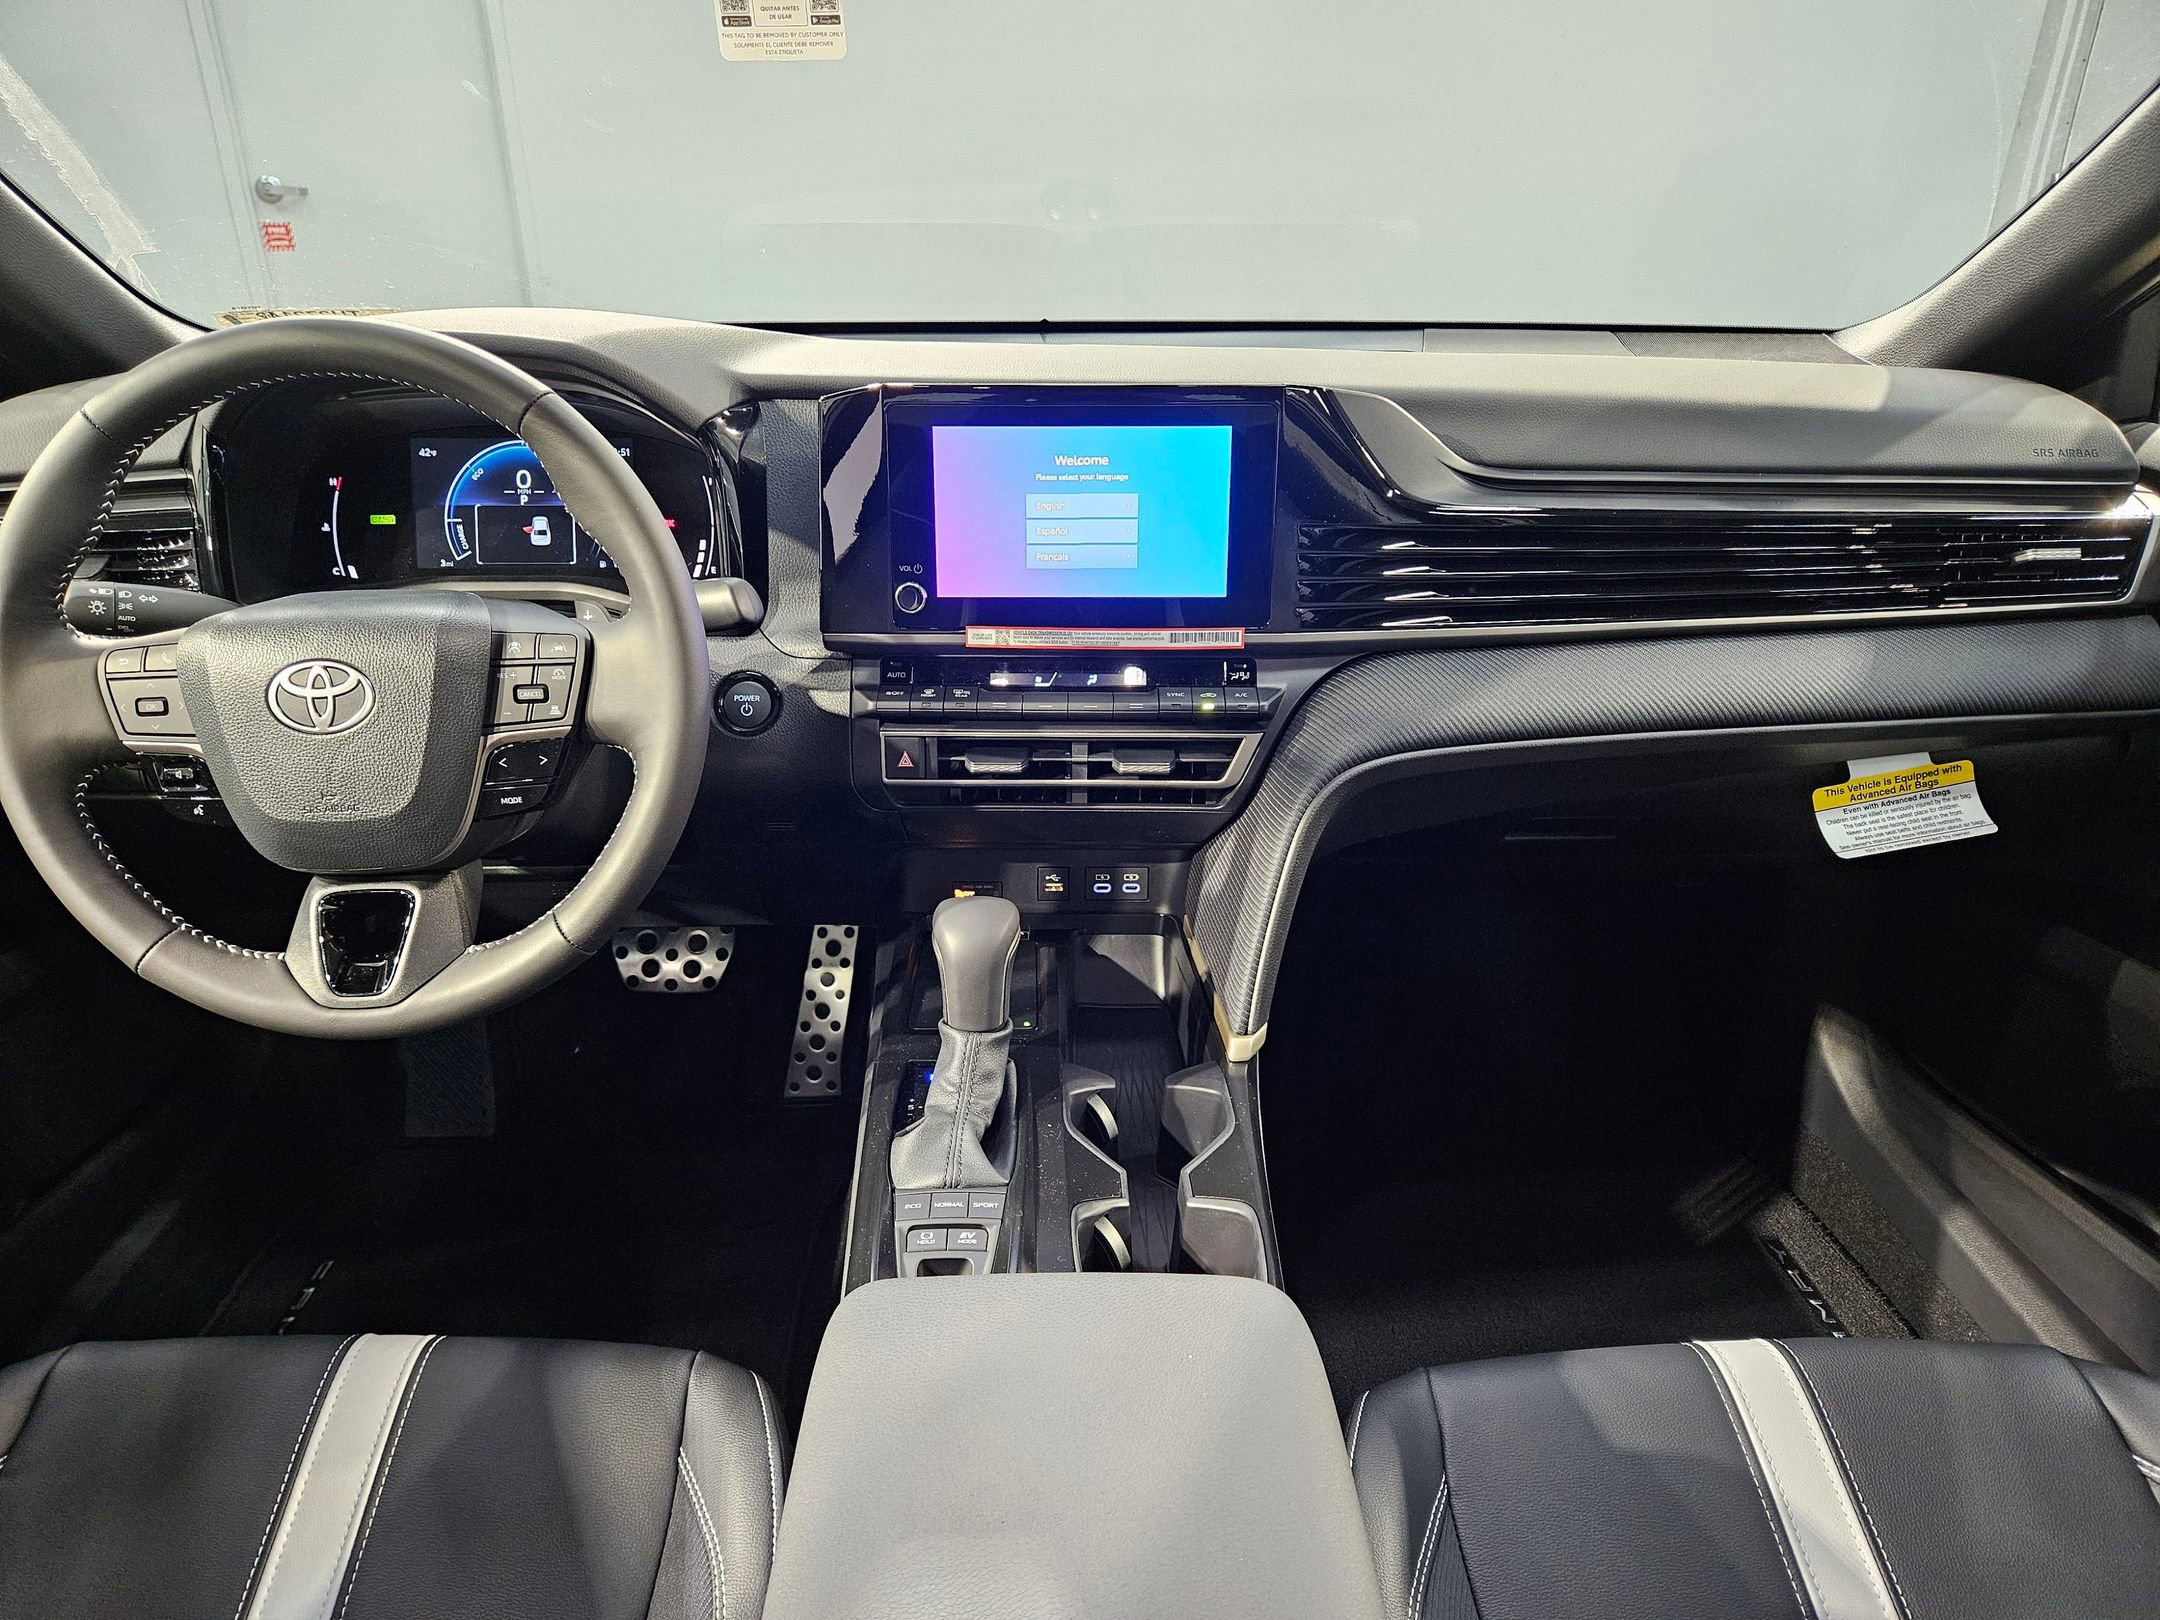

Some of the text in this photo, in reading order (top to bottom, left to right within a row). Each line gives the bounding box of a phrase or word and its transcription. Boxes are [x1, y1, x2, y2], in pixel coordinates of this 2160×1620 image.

[617, 448, 630, 457] :51
[2033, 448, 2099, 458] SRS AIRBAG
[1054, 455, 1110, 466] Welcome
[472, 468, 484, 481] ECO
[1035, 473, 1129, 482] Please select your language
[520, 495, 529, 506] P
[1036, 502, 1065, 512] English
[1036, 528, 1068, 537] Español
[1036, 552, 1069, 563] Français
[710, 566, 717, 575] E
[734, 694, 760, 702] POWER
[1824, 764, 1962, 797] This Vehicle is Equipped with
[1850, 779, 1939, 802] Advanced Air Bags
[500, 796, 523, 805] MODE
[1843, 789, 1951, 815] Even with Advanced Air Bags
[1826, 816, 1849, 826] Children
[1869, 810, 1882, 818] killed
[1890, 804, 1914, 813] seriously
[1916, 800, 1934, 810] injured
[1914, 809, 1929, 817] place
[1907, 816, 1921, 824] child
